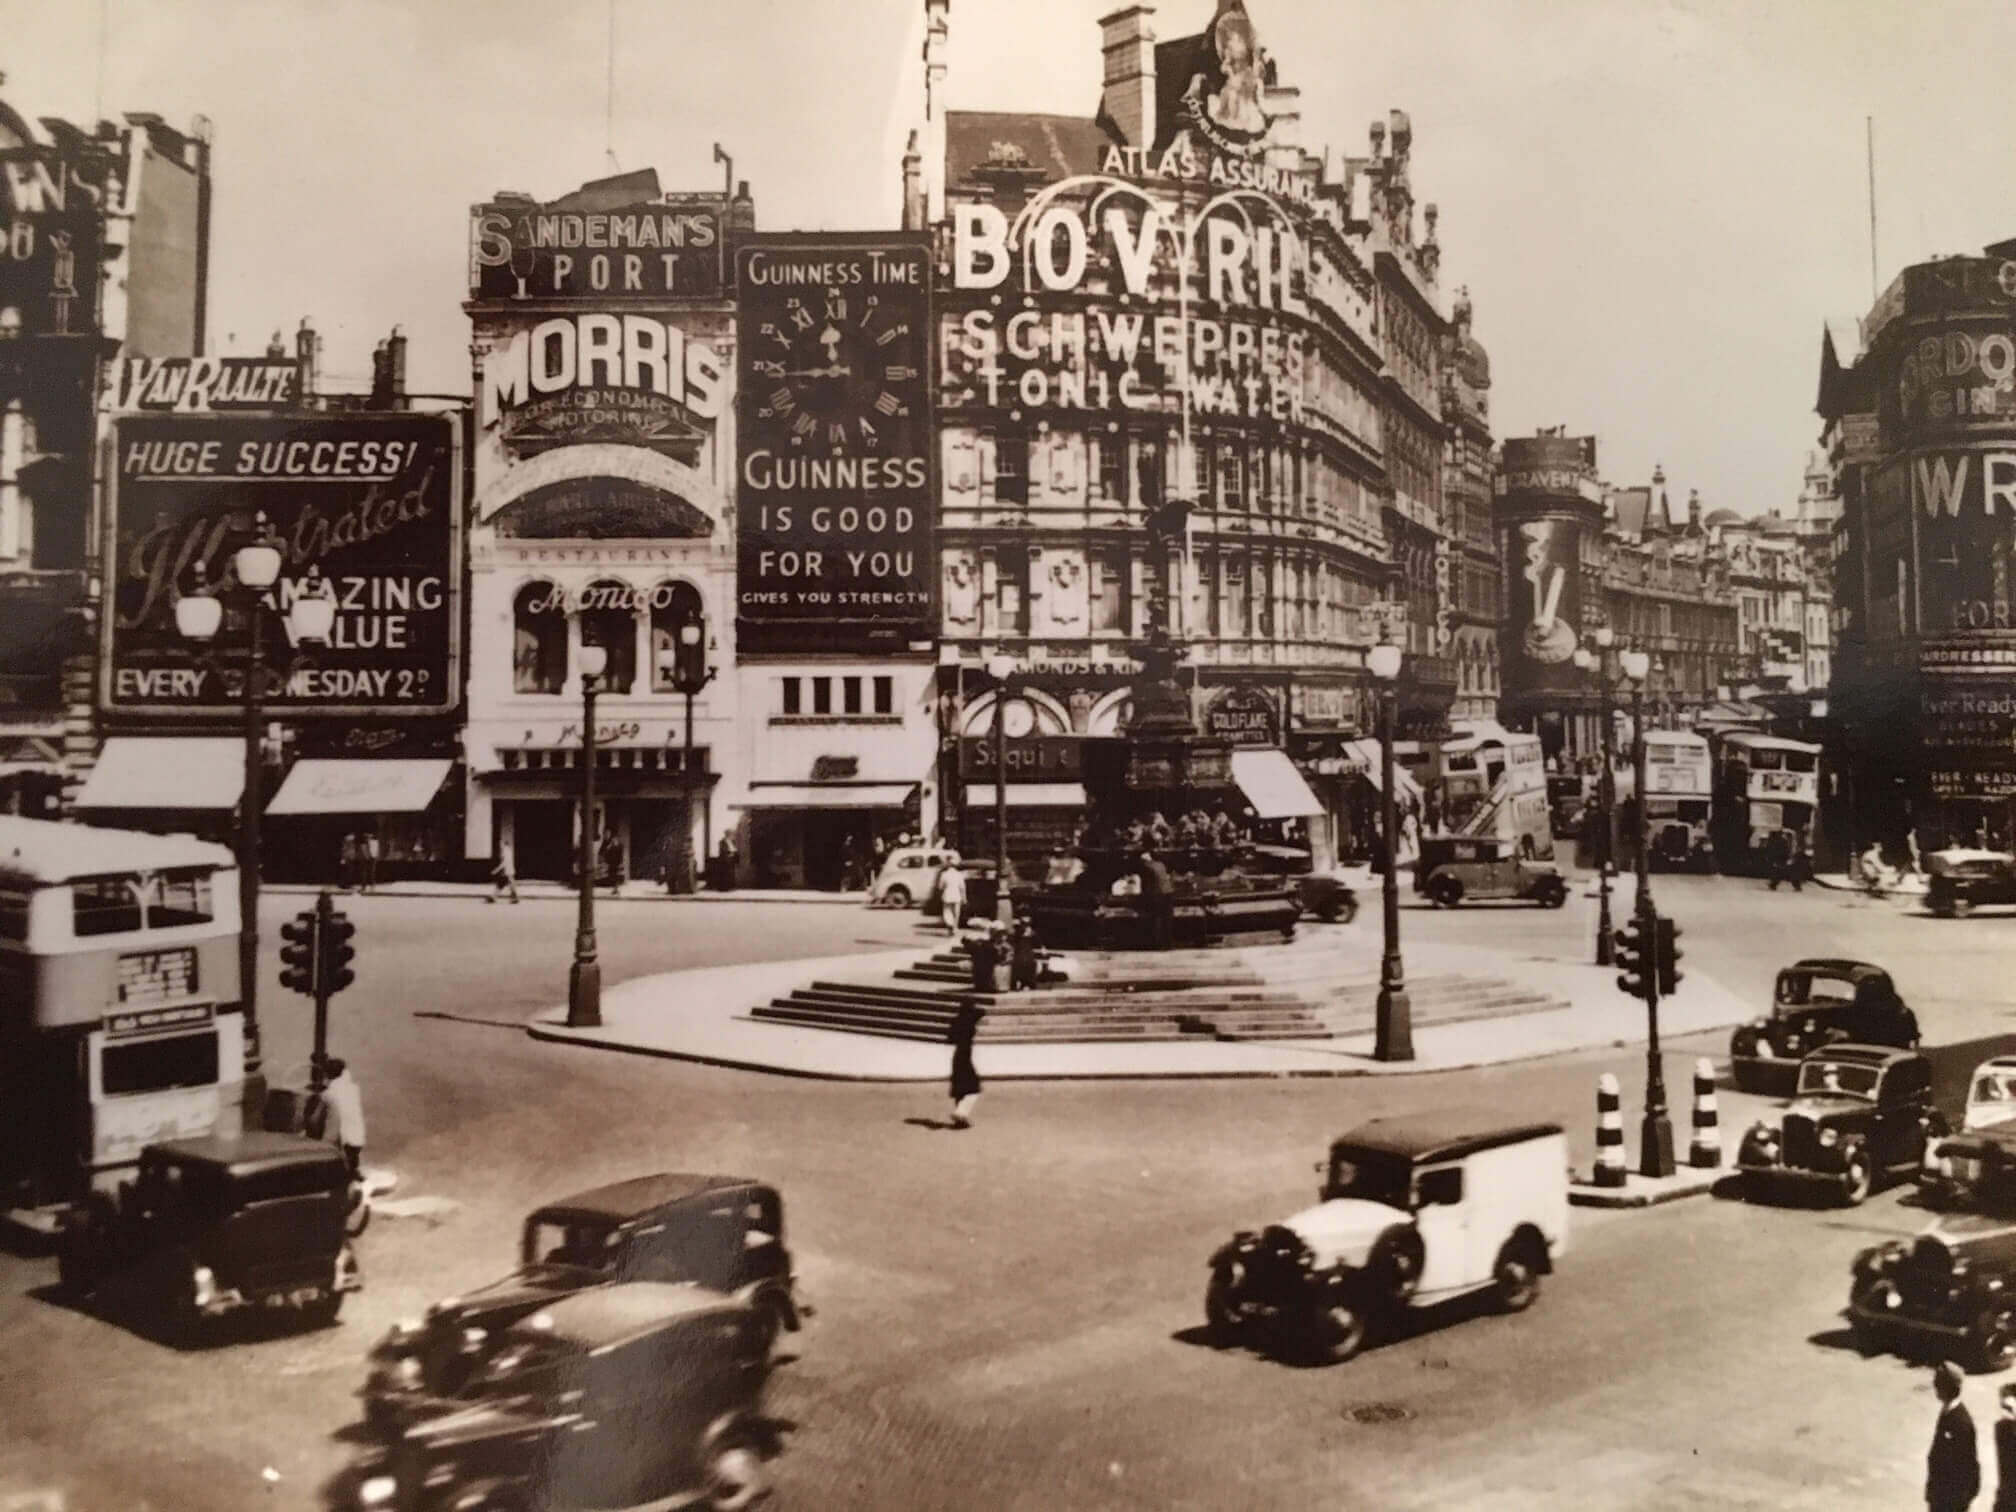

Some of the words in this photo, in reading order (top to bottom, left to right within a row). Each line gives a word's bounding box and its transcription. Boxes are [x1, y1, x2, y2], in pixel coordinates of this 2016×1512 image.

[1103, 146, 1197, 179] ATLAS
[554, 254, 679, 290] PORT
[749, 252, 862, 285] GUINNESS
[867, 251, 920, 285] TIME
[954, 203, 1309, 316] BOVRIL
[960, 309, 1304, 378] SCHWEPPES
[482, 313, 721, 430] MORRIS
[976, 368, 1142, 409] TONIC
[124, 441, 222, 474] HUGE
[236, 441, 418, 475] SUCCESS!
[744, 450, 927, 490] GUINNESS
[760, 505, 793, 532] IS
[811, 506, 914, 533] GOOD
[759, 551, 824, 577] FOR
[847, 551, 914, 577] YOU
[262, 576, 442, 611] MAZING
[742, 592, 789, 605] GIVES
[797, 592, 832, 605] YOU
[838, 592, 929, 605] STRENGTH
[282, 616, 407, 649] VLUE
[116, 668, 208, 698] EVERY
[222, 668, 389, 699] NESDAY
[556, 722, 641, 746] Mnico
